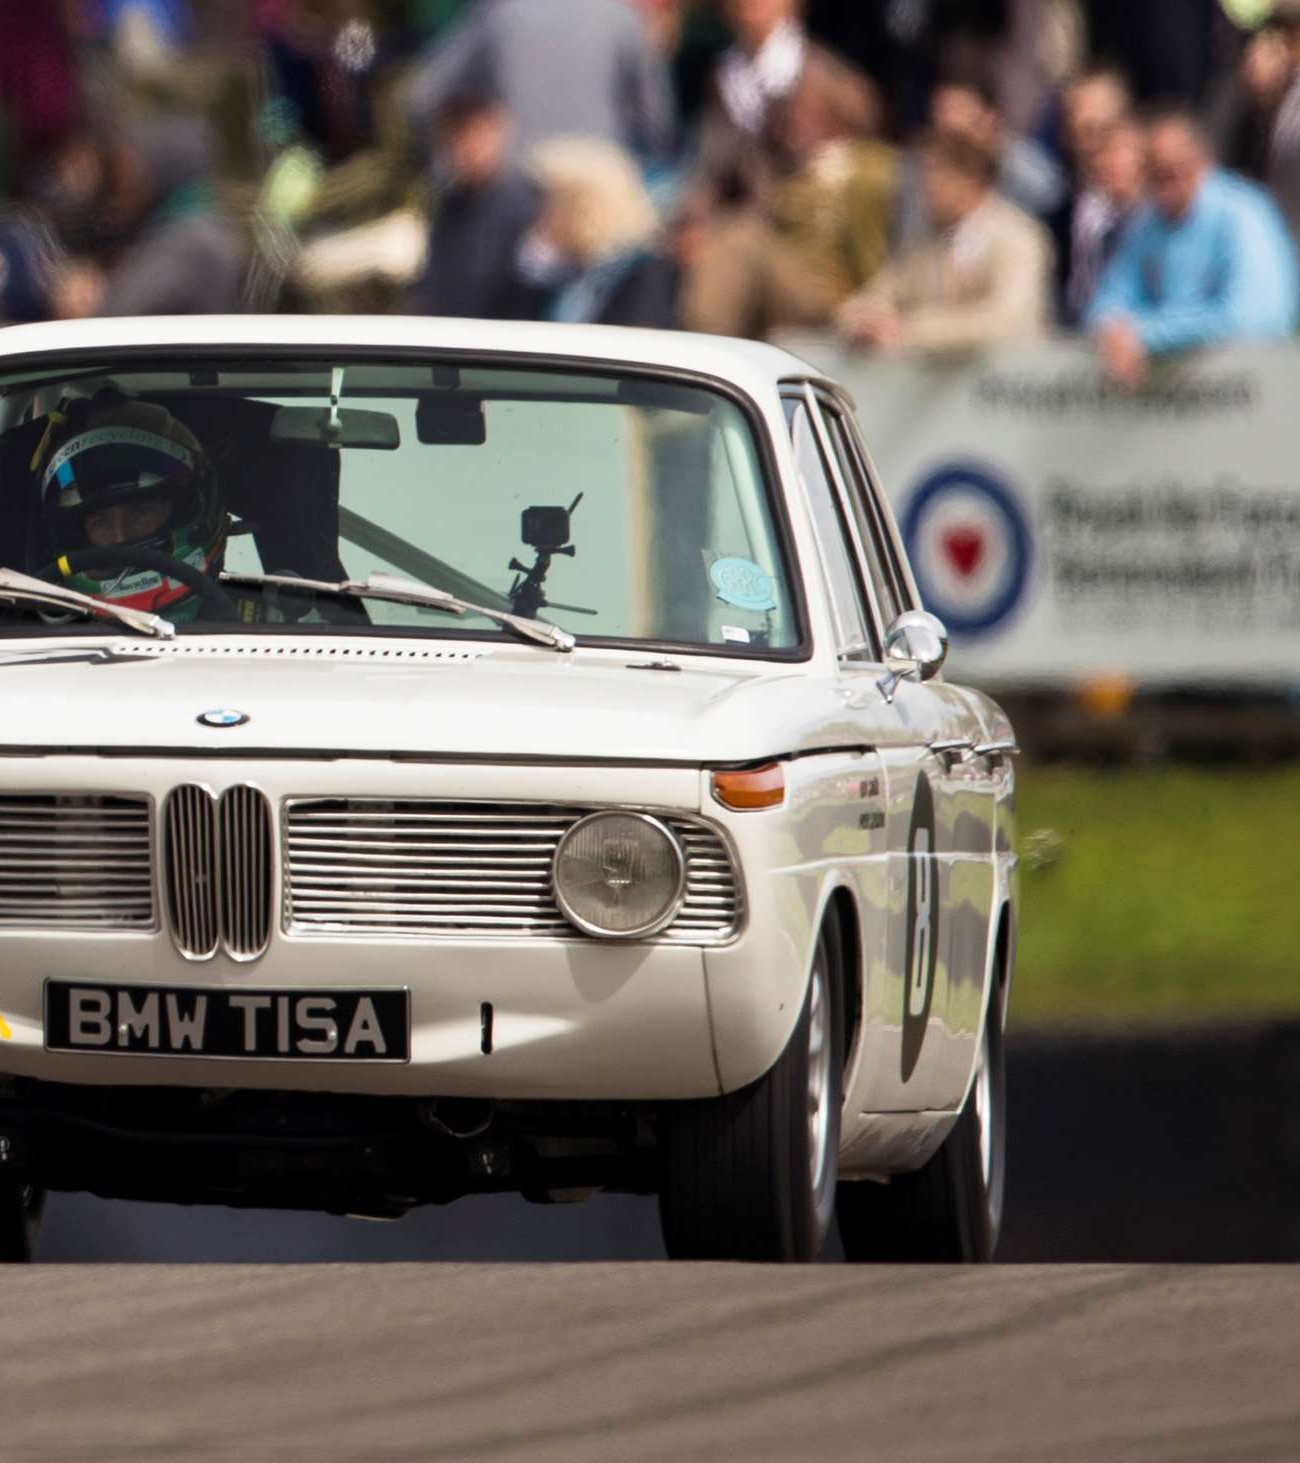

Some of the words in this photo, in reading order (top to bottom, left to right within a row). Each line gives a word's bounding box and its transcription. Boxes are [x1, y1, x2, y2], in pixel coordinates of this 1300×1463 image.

[908, 826, 932, 1017] 8
[68, 987, 208, 1049] BMW
[229, 996, 387, 1053] TISA
